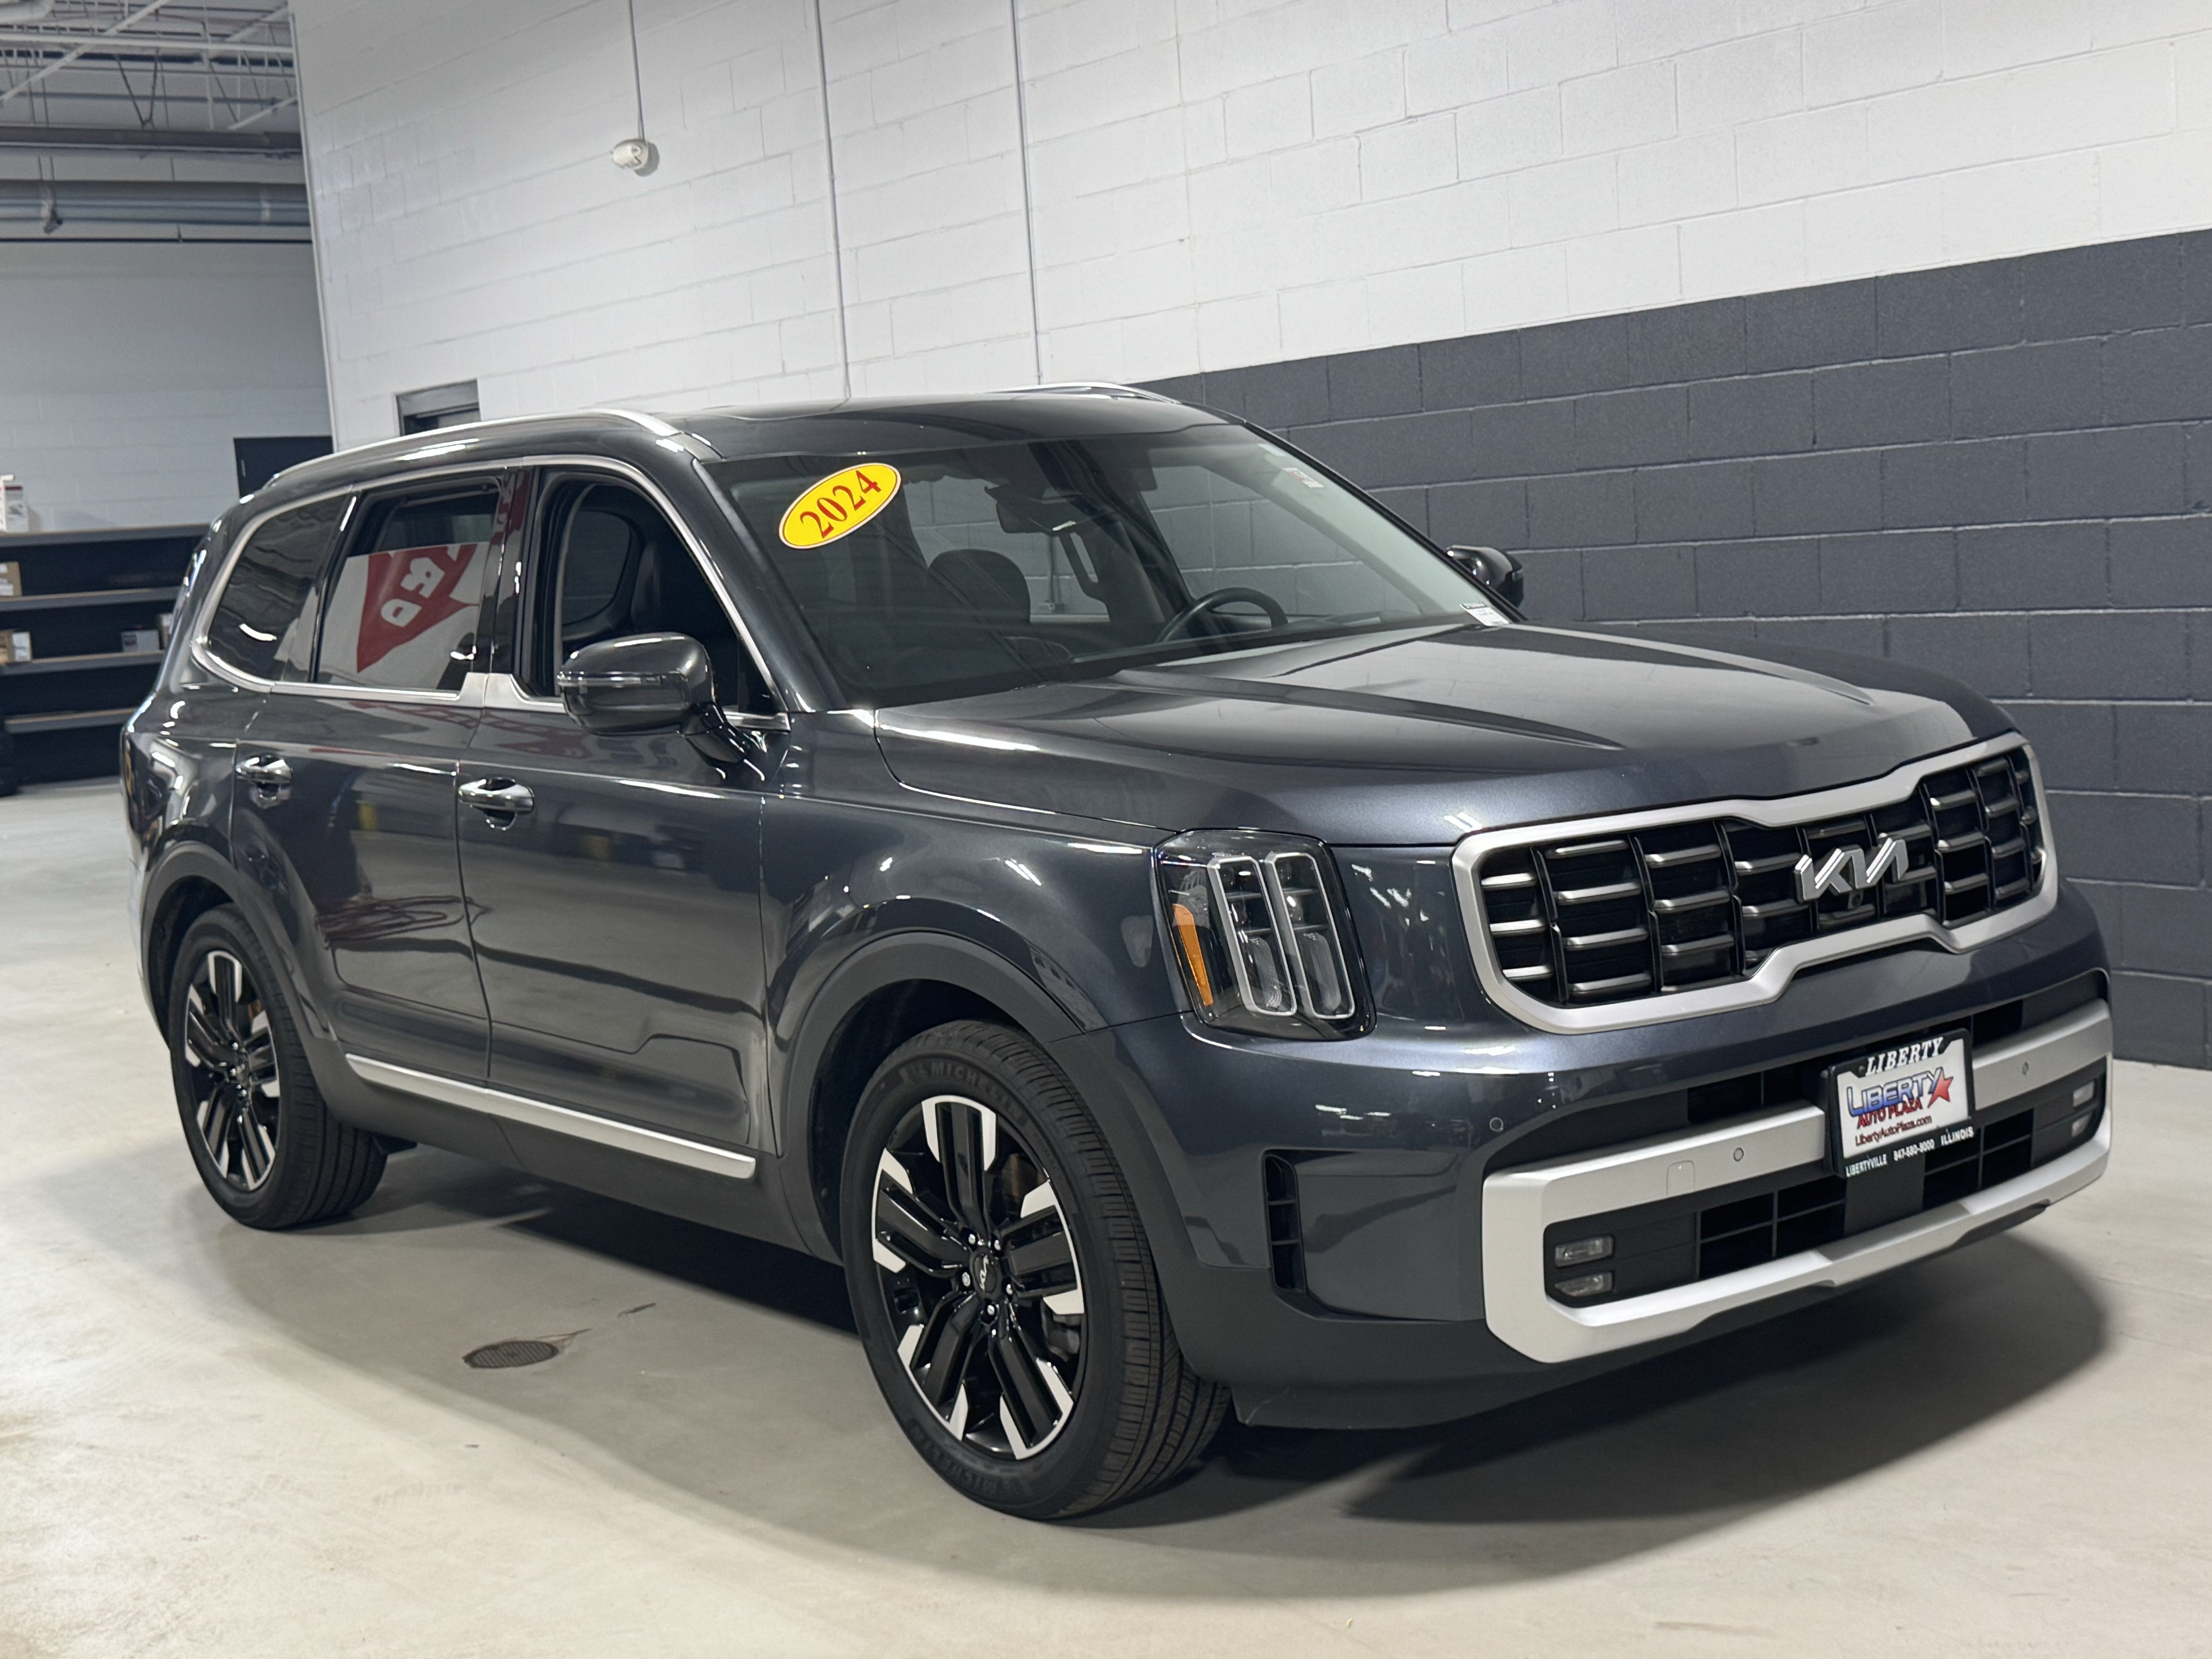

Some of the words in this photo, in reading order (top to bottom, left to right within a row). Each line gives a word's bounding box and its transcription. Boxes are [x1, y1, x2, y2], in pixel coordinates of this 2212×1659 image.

[800, 470, 881, 538] 2024
[1795, 837, 1909, 900] KIA
[1865, 1036, 1944, 1076] LIBERTY
[931, 1061, 1024, 1121] MICHELIN
[1846, 1066, 1944, 1118] LIBERTY
[1856, 1108, 1886, 1129] AUTO
[1888, 1097, 1923, 1119] PLAZA
[1846, 1153, 1887, 1178] LIBERTYVILLE
[1941, 1126, 1974, 1146] ILLINOIS
[1855, 1115, 1932, 1146] LibertyAutoPlaza.com
